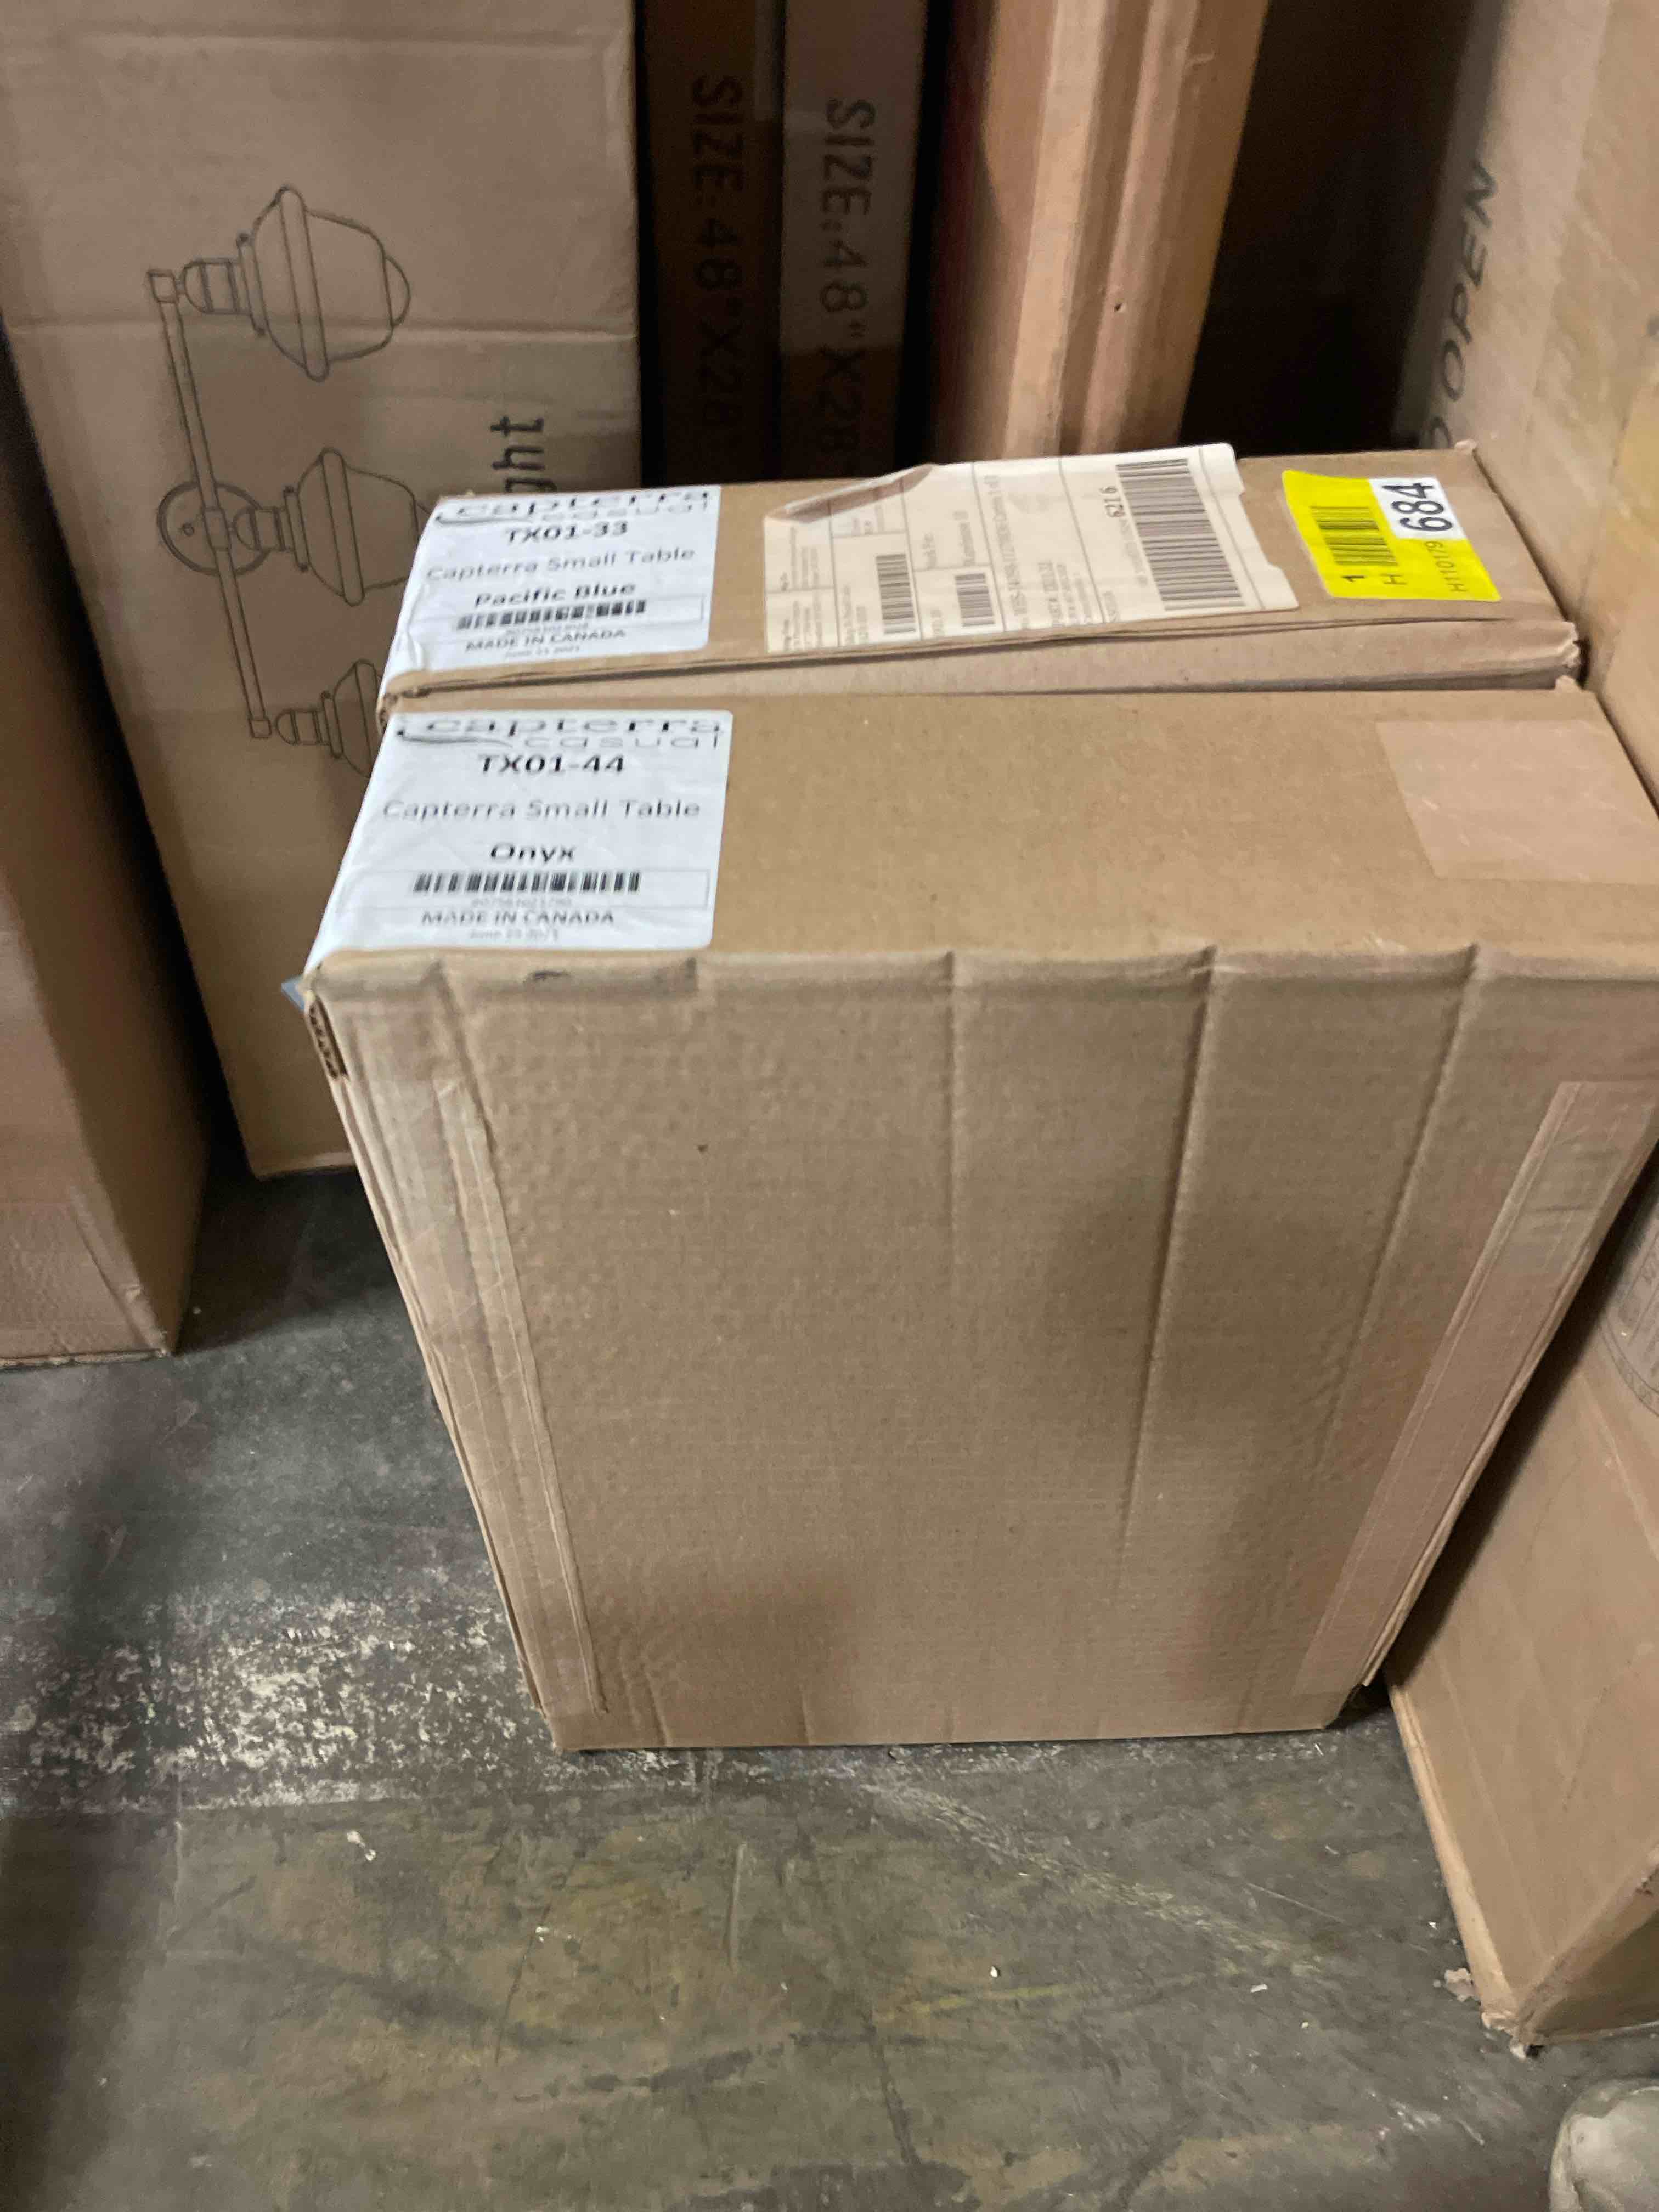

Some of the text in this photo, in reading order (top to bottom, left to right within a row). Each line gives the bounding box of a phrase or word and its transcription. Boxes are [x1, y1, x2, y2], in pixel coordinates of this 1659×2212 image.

[1443, 161, 1498, 402] OPEN
[1381, 482, 1452, 532] 684
[505, 520, 629, 544] TX01-33
[426, 548, 695, 582] Capterra Small Table
[1381, 573, 1407, 586] H
[475, 583, 636, 608] Pacific Blue
[466, 629, 625, 651] MADE IN CANADA
[478, 754, 625, 774] TX01-44
[383, 799, 701, 821] Capterra Small Table
[490, 842, 577, 864] Onyx
[422, 911, 614, 924] MADE IN CANADA
